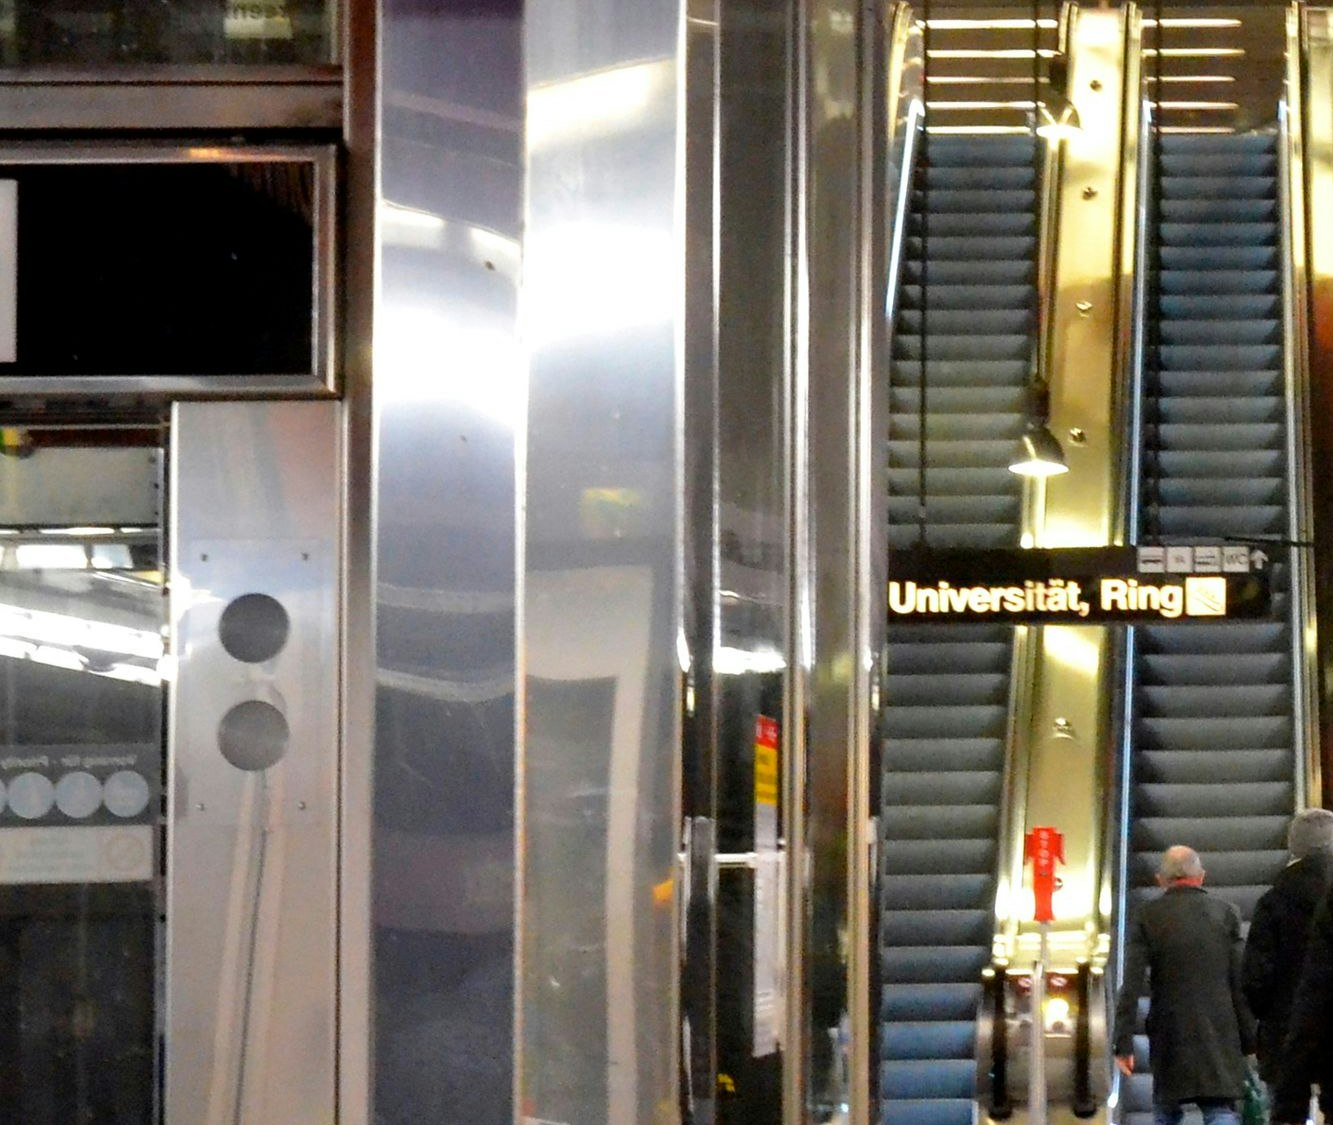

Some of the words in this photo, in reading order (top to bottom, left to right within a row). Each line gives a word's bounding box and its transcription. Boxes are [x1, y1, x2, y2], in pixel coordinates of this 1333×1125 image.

[1226, 553, 1248, 565] WC
[888, 578, 1090, 617] Universität,
[1100, 578, 1183, 618] Ring
